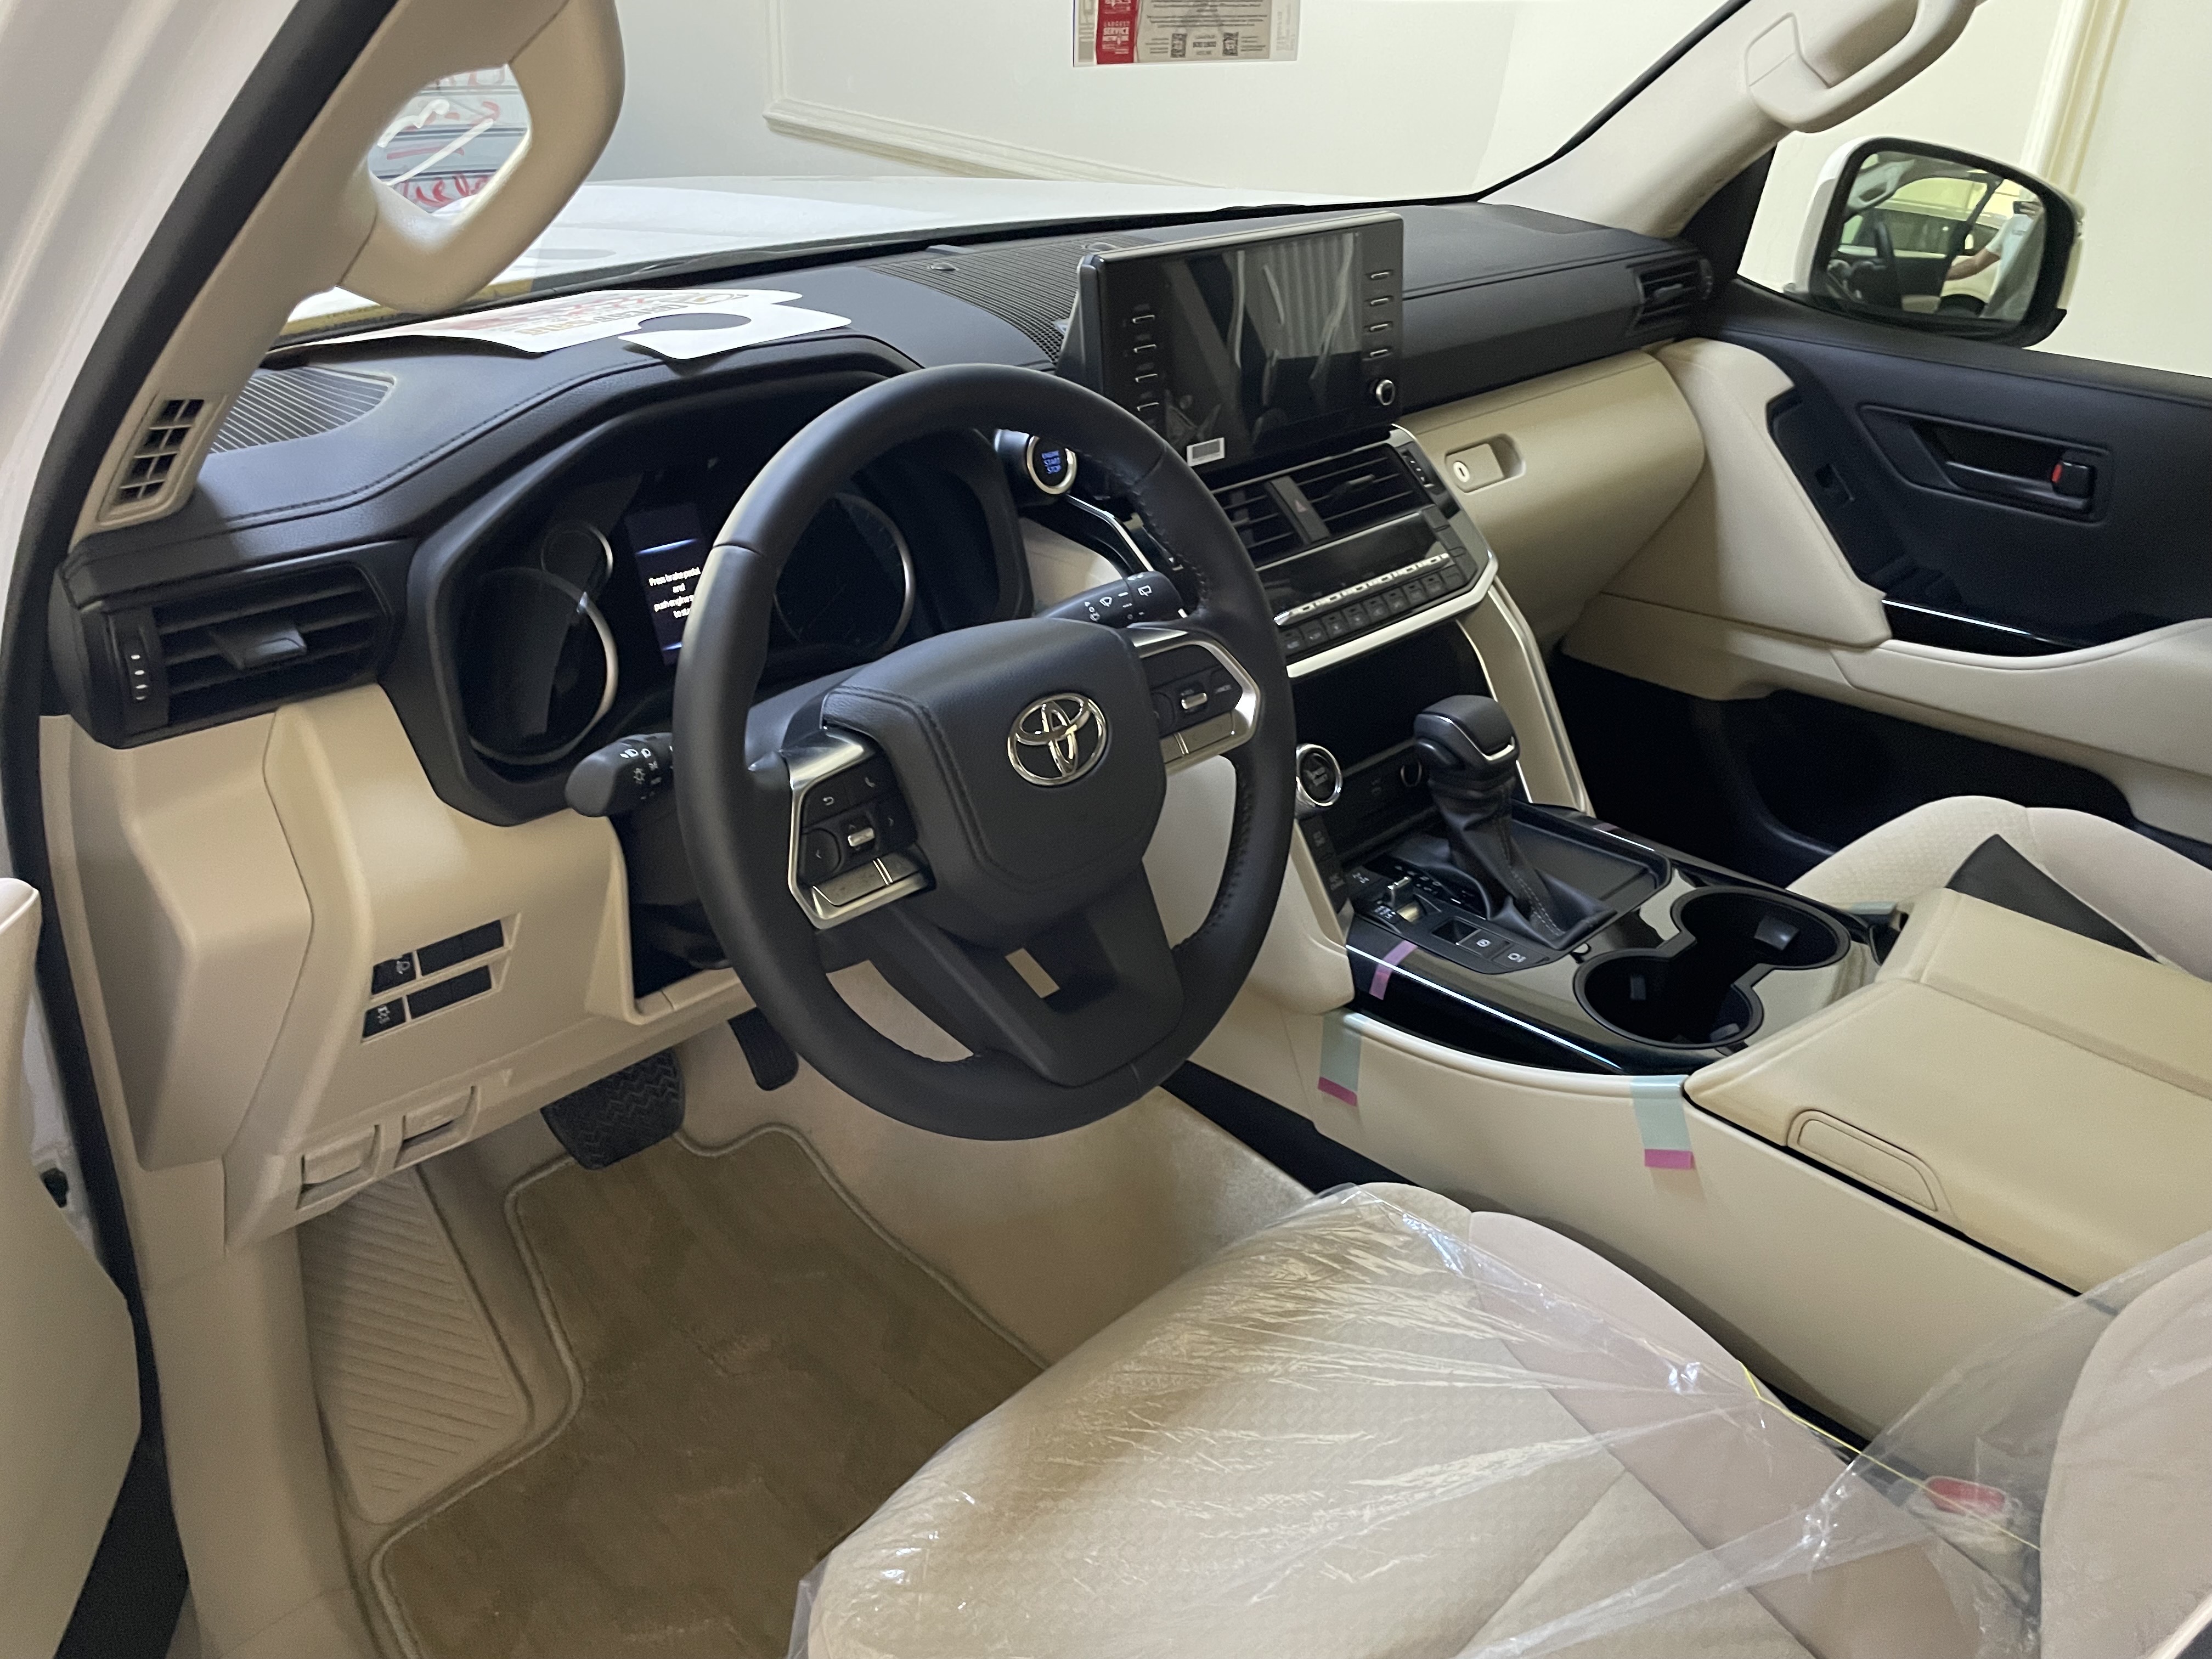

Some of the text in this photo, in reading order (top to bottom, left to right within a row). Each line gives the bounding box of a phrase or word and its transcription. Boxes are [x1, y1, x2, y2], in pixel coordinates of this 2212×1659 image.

[648, 566, 701, 586] Press brake pedal
[672, 583, 686, 593] and
[653, 600, 670, 612] push
[673, 610, 682, 618] to
